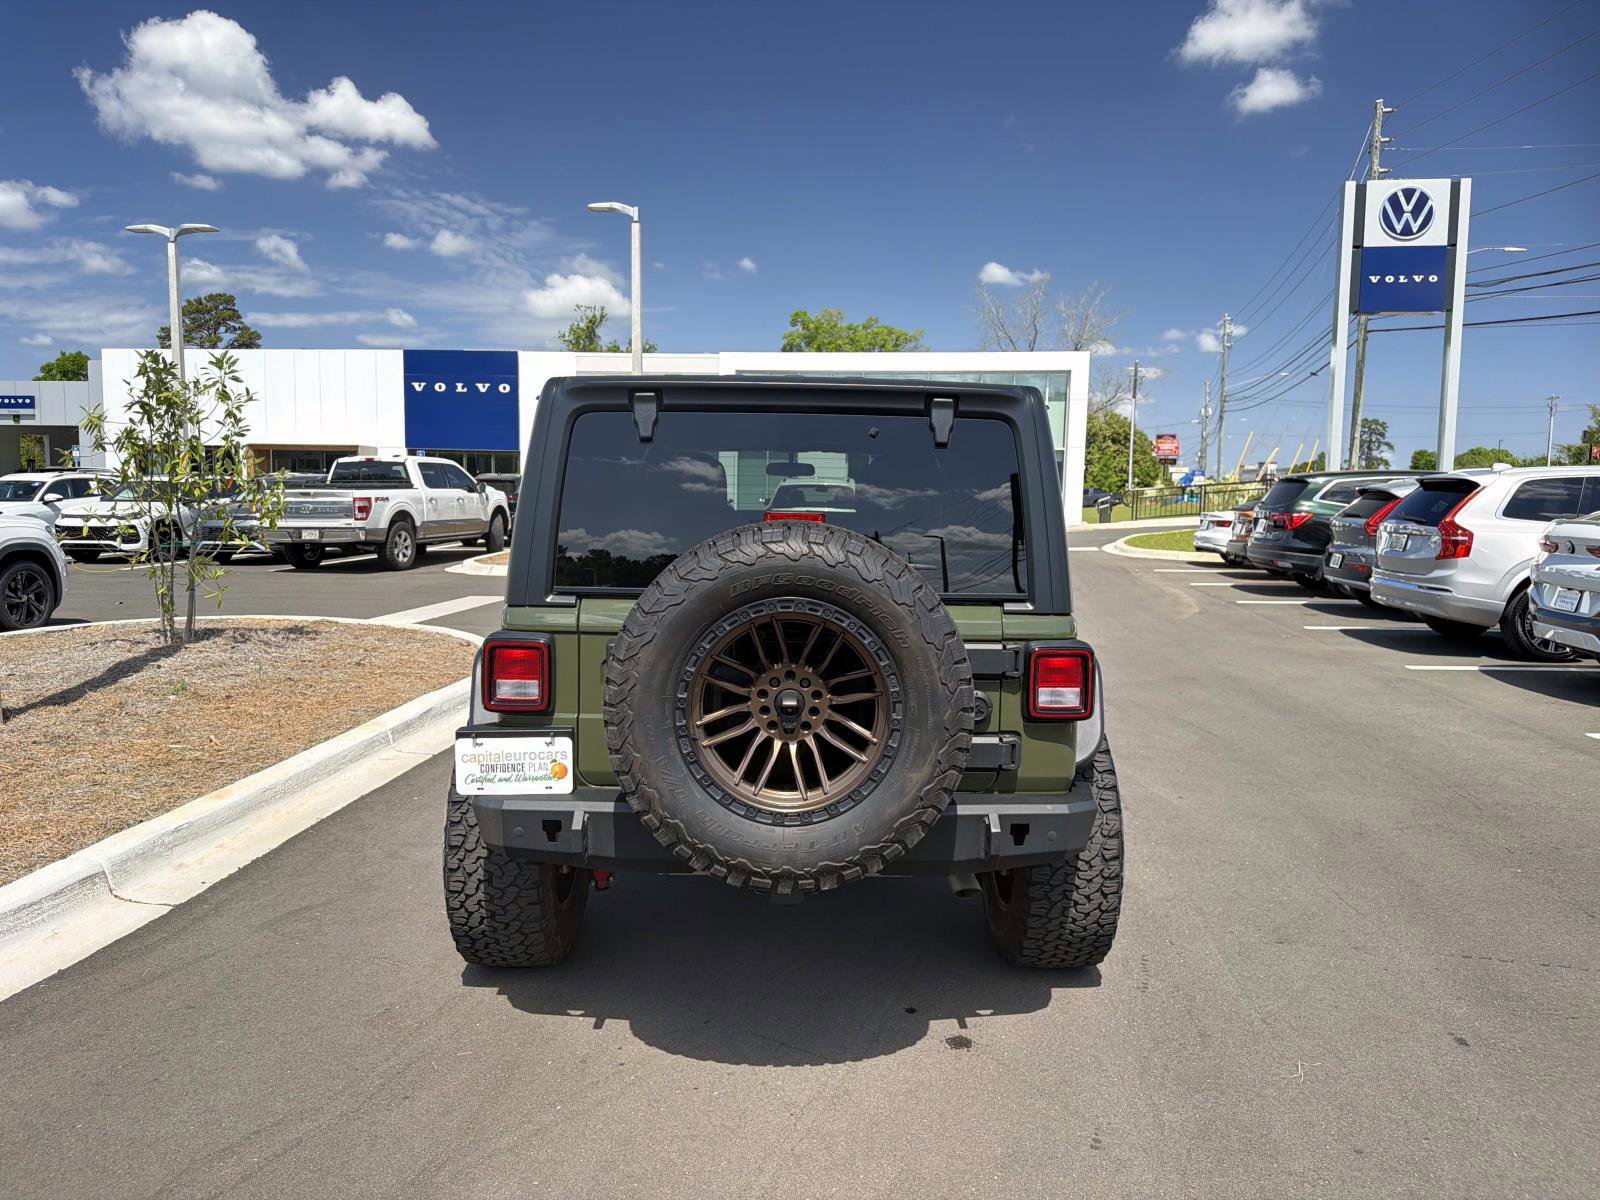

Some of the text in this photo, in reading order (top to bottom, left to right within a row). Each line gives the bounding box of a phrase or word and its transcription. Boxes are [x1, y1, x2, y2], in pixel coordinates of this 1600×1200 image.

[1369, 275, 1438, 284] VOLVO
[411, 381, 511, 394] VOLVO
[729, 572, 910, 649] BFGoodrich
[461, 749, 568, 765] capitaleurocars
[480, 762, 549, 773] CONFIDENCE PLAN
